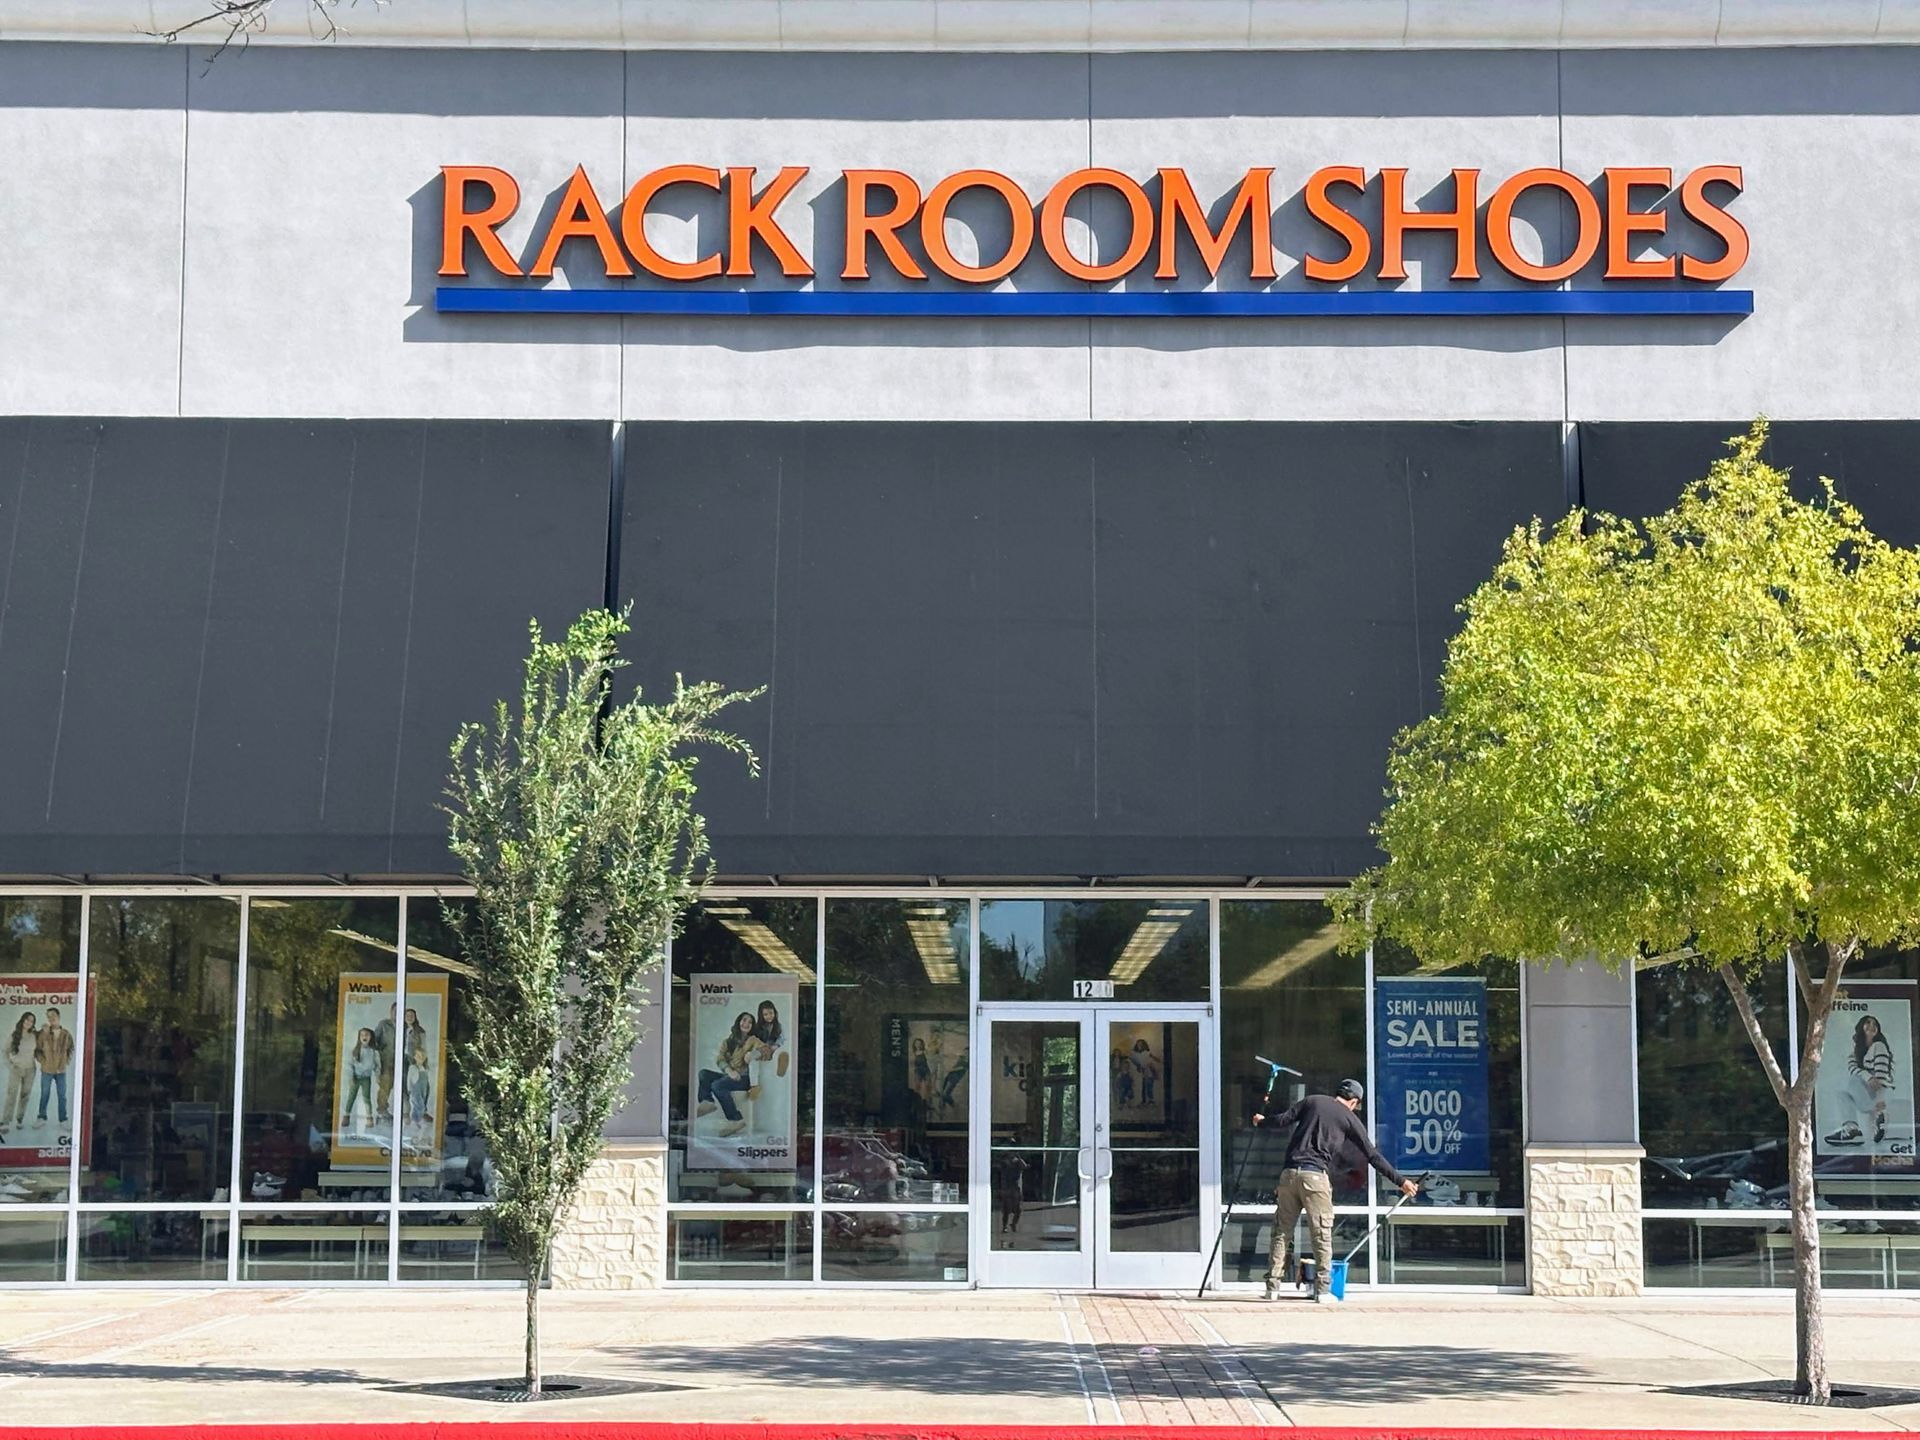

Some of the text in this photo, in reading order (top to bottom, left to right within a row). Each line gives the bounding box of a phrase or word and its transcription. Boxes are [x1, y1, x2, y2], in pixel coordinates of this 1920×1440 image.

[437, 164, 1751, 284] RACK ROOM SHOES
[348, 983, 383, 993] Want
[699, 983, 733, 994] Want
[9, 995, 47, 1006] Stand
[49, 995, 73, 1005] Out
[348, 994, 372, 1005] Fun
[700, 995, 730, 1007] Cozy
[1386, 1000, 1479, 1016] SEMI-ANNUAL
[890, 1018, 902, 1058] MEN'S
[1386, 1019, 1480, 1048] SALE
[1405, 1089, 1462, 1116] BOGO
[766, 1135, 789, 1146] Get
[1405, 1118, 1462, 1155] 50%
[737, 1146, 788, 1159] Slippers
[1444, 1143, 1462, 1154] OFF
[1890, 1143, 1913, 1154] Get
